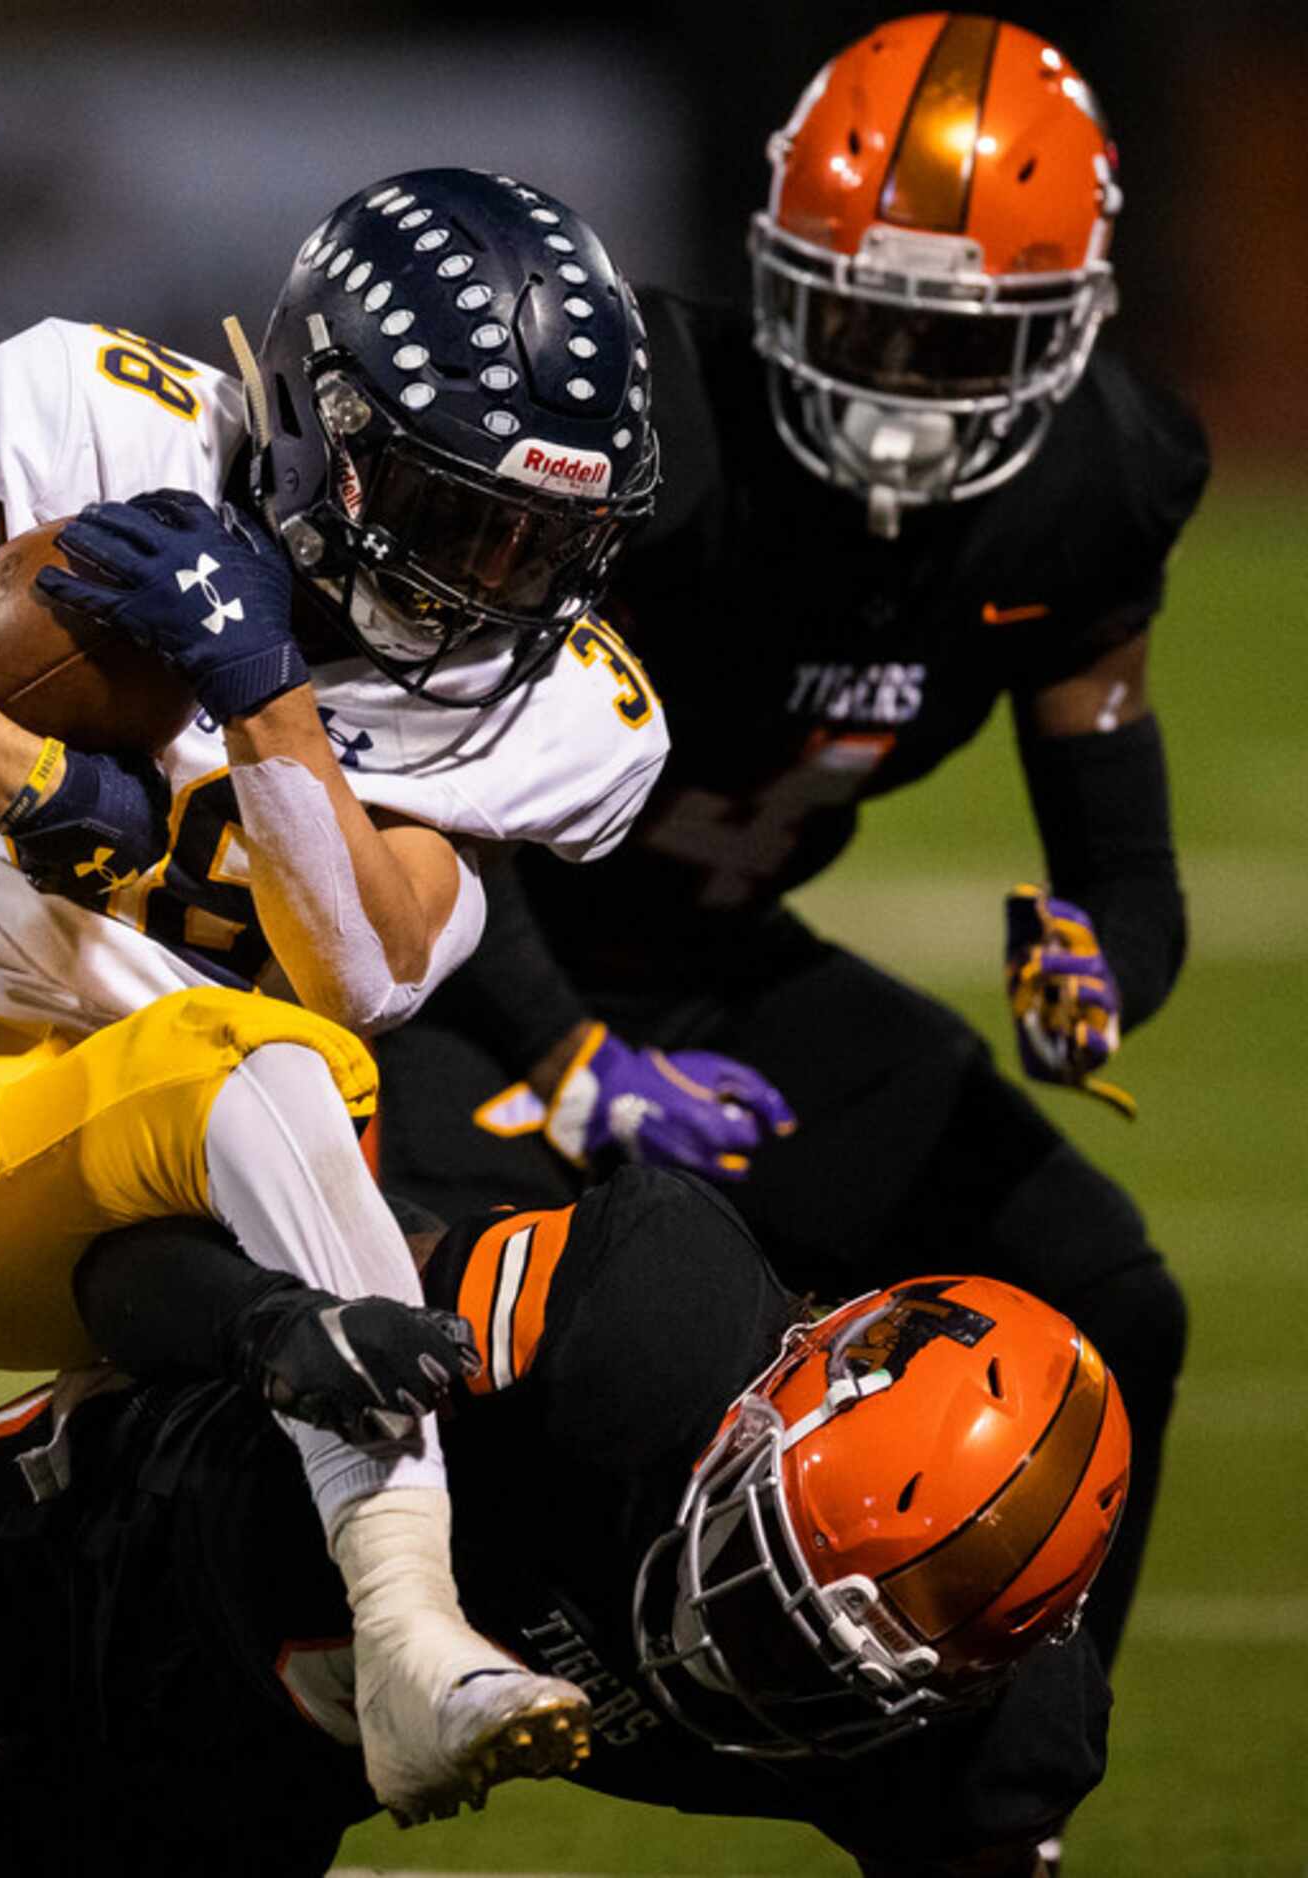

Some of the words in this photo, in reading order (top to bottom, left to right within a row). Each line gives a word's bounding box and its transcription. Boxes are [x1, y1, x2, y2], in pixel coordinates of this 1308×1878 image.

[523, 447, 607, 484] Riddell
[565, 610, 662, 732] 3
[788, 664, 925, 723] TIGERS
